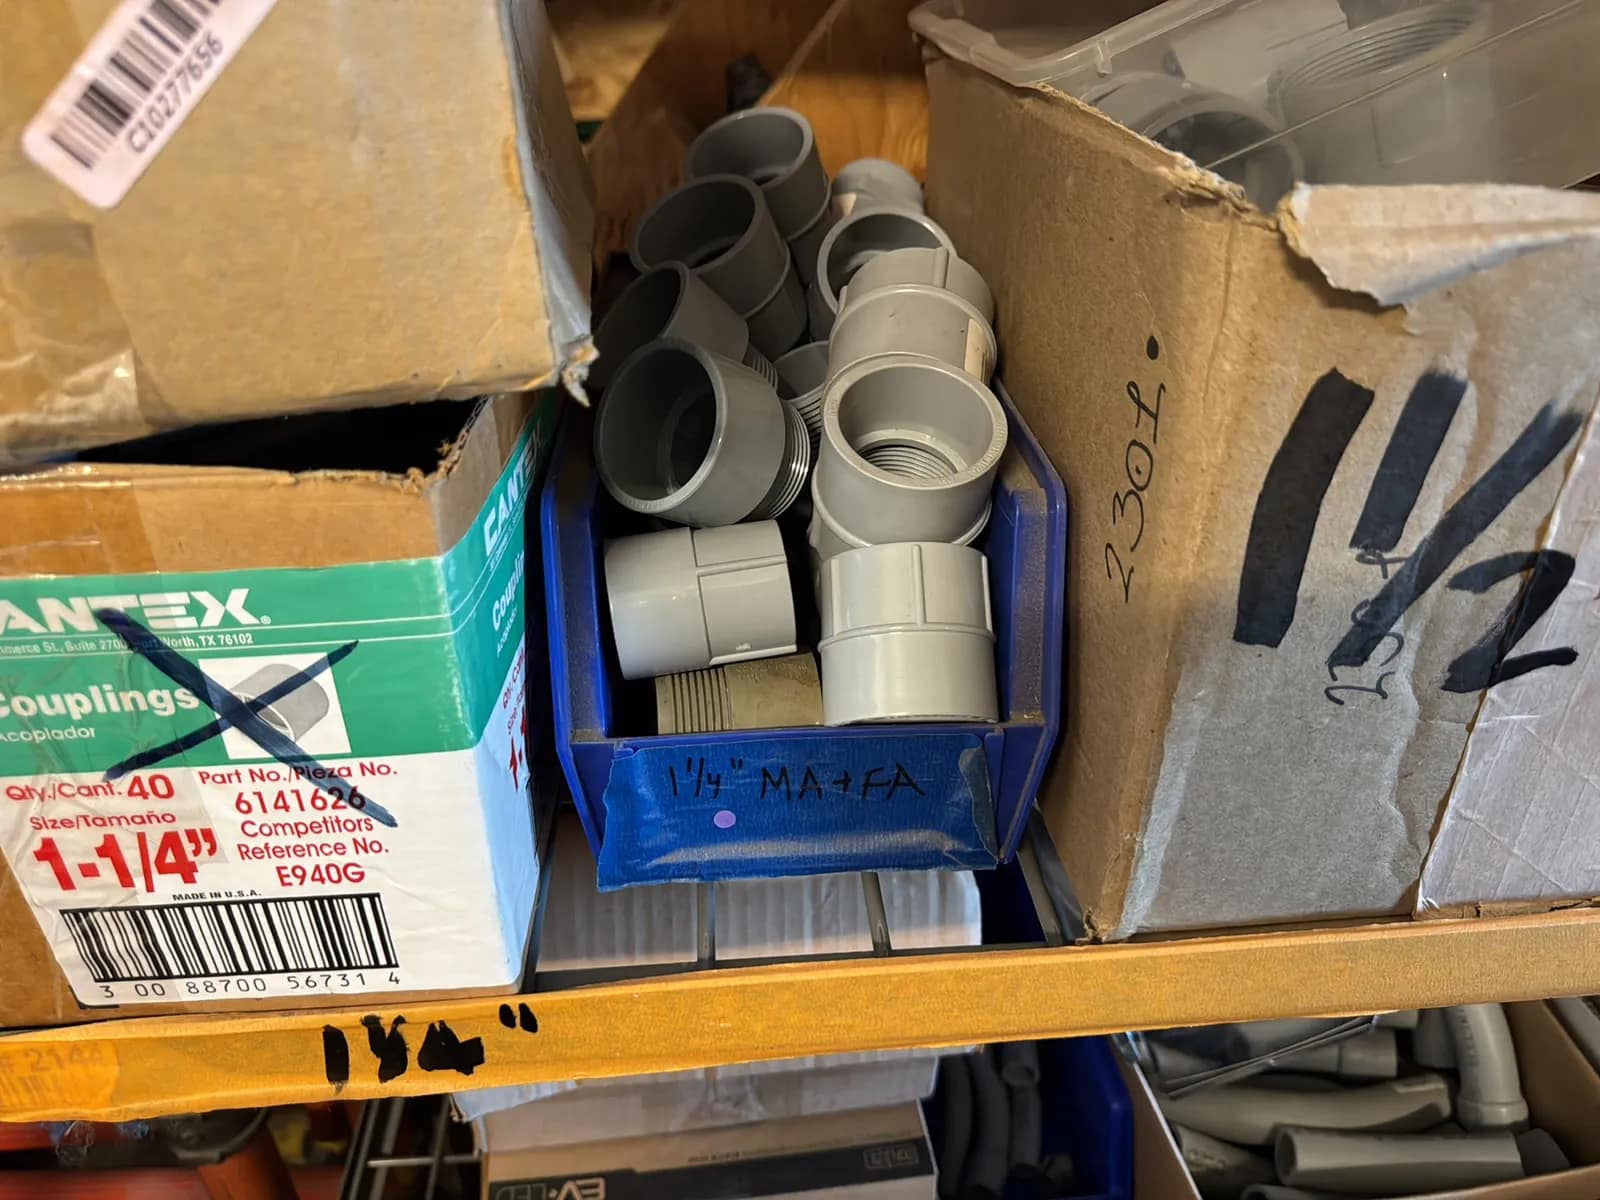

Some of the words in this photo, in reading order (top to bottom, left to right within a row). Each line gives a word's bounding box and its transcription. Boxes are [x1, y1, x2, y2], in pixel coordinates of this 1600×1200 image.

[127, 31, 223, 153] C10277656
[64, 640, 97, 652] Suite
[199, 634, 217, 646] TX
[218, 632, 253, 645] 76102
[199, 769, 242, 785] Part
[249, 764, 353, 783] No./Pieza
[359, 761, 398, 778] No.
[6, 781, 122, 807] Qty./Cant.
[127, 774, 175, 800] 40
[235, 785, 367, 815] 6141626
[30, 811, 177, 831] Size/Tamaño
[241, 815, 374, 838] Competitors
[237, 842, 347, 861] Reference
[352, 837, 390, 855] No.
[276, 863, 365, 887] E940G
[172, 892, 207, 901] MADE
[209, 891, 222, 899] IN
[224, 889, 262, 899] U.S.A.
[100, 985, 114, 999] 3
[135, 983, 166, 997] 00
[186, 977, 267, 994] 88700
[287, 972, 367, 990] 56731
[388, 972, 400, 985] 4
